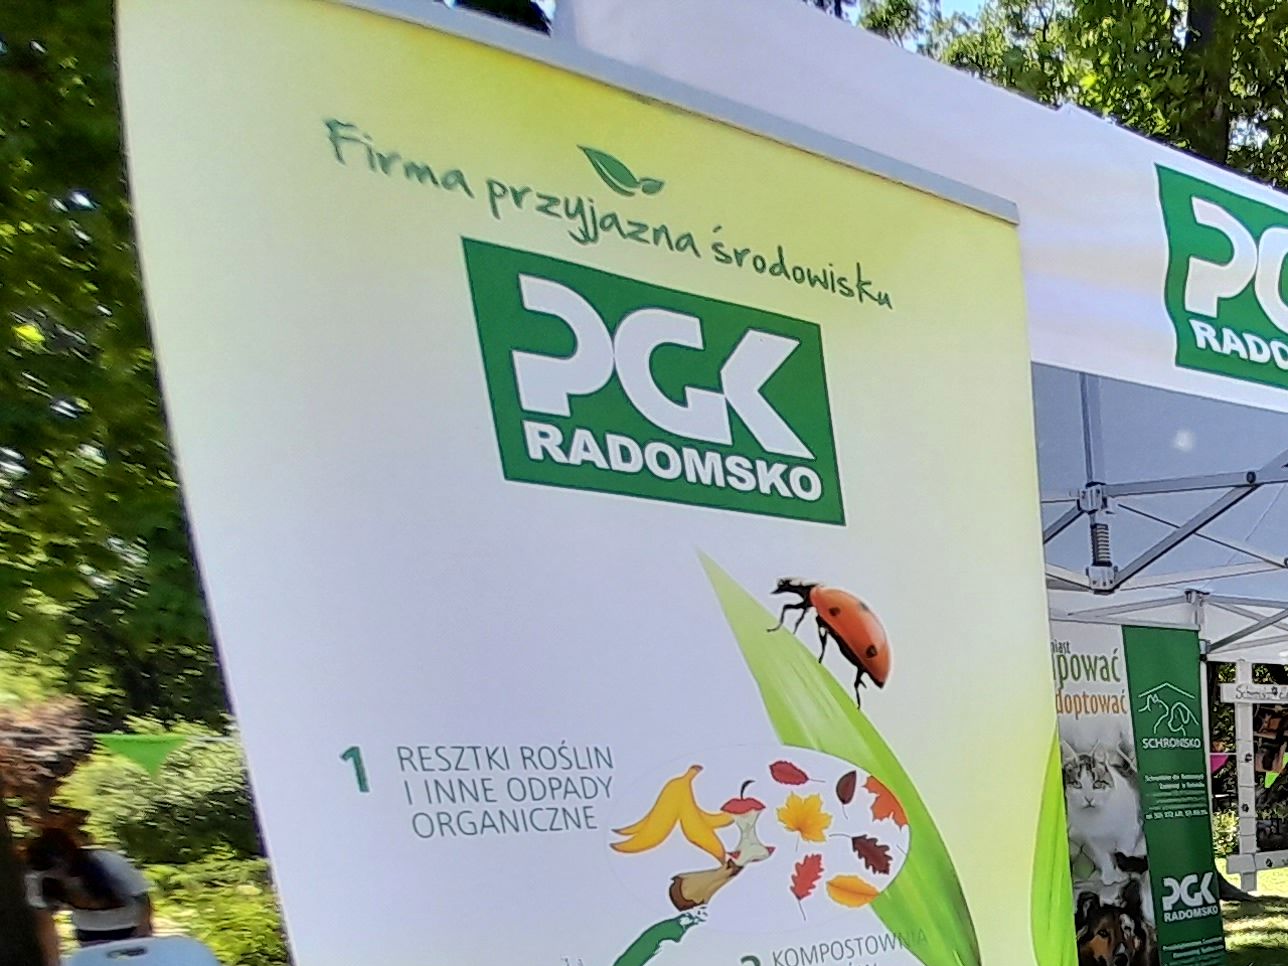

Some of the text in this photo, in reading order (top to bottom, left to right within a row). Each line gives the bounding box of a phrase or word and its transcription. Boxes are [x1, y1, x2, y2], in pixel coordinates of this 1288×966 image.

[324, 118, 893, 309] Firma przyjazna środowisku
[511, 272, 816, 460] PGK
[522, 419, 823, 502] RADOMSKO
[396, 740, 615, 772] RESZTKI ROŚLIN
[1142, 737, 1201, 750] SCHRONISKO
[339, 746, 371, 793] 1
[405, 774, 614, 805] I INNE ODPADY
[411, 805, 599, 839] ORGANICZNE
[1162, 871, 1217, 912] PGK
[1163, 904, 1219, 922] RADOMSKO
